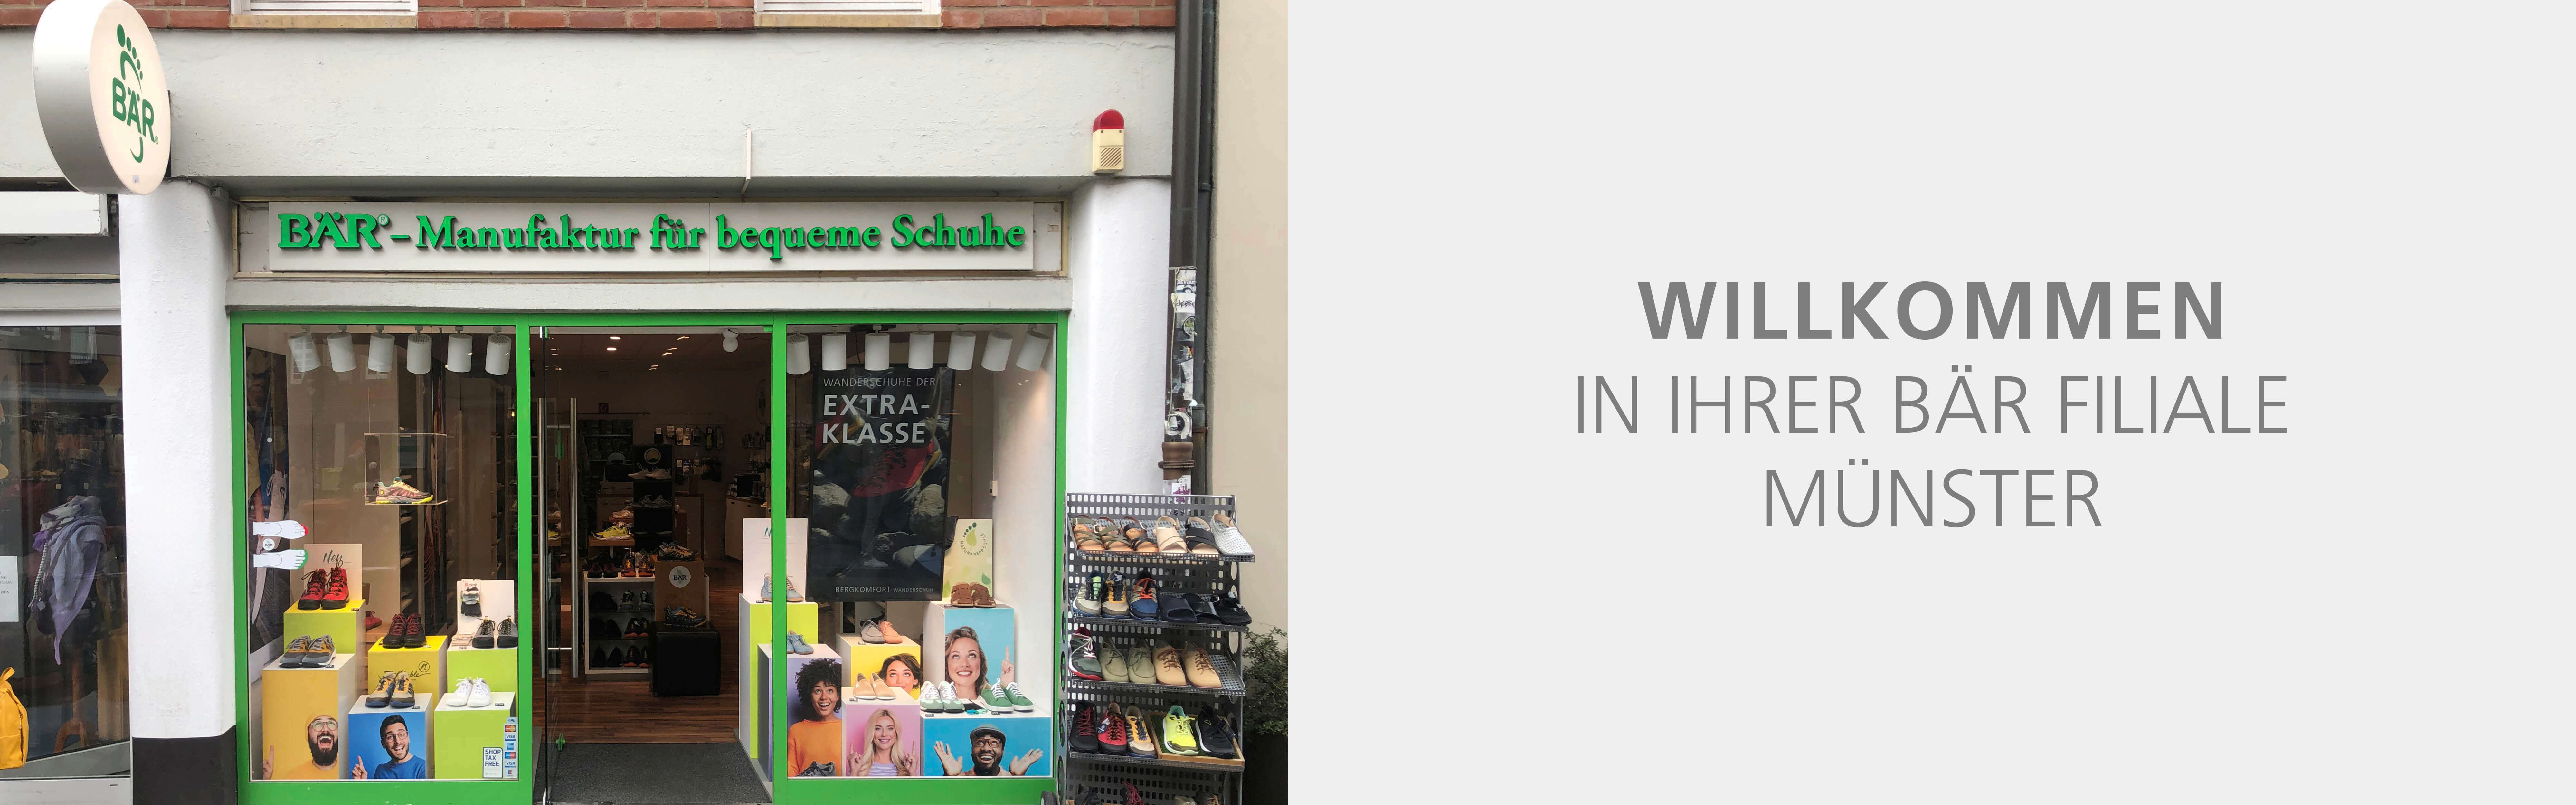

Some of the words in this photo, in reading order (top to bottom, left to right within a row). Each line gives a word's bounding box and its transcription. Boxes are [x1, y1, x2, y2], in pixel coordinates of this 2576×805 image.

[650, 214, 705, 249] für
[716, 214, 881, 260] bequeme
[891, 213, 1026, 248] Schuhe
[823, 378, 911, 387] WANDERSCHUHE
[916, 378, 935, 386] DER
[824, 394, 930, 415] EXTRA-
[822, 422, 925, 444] KLASSE
